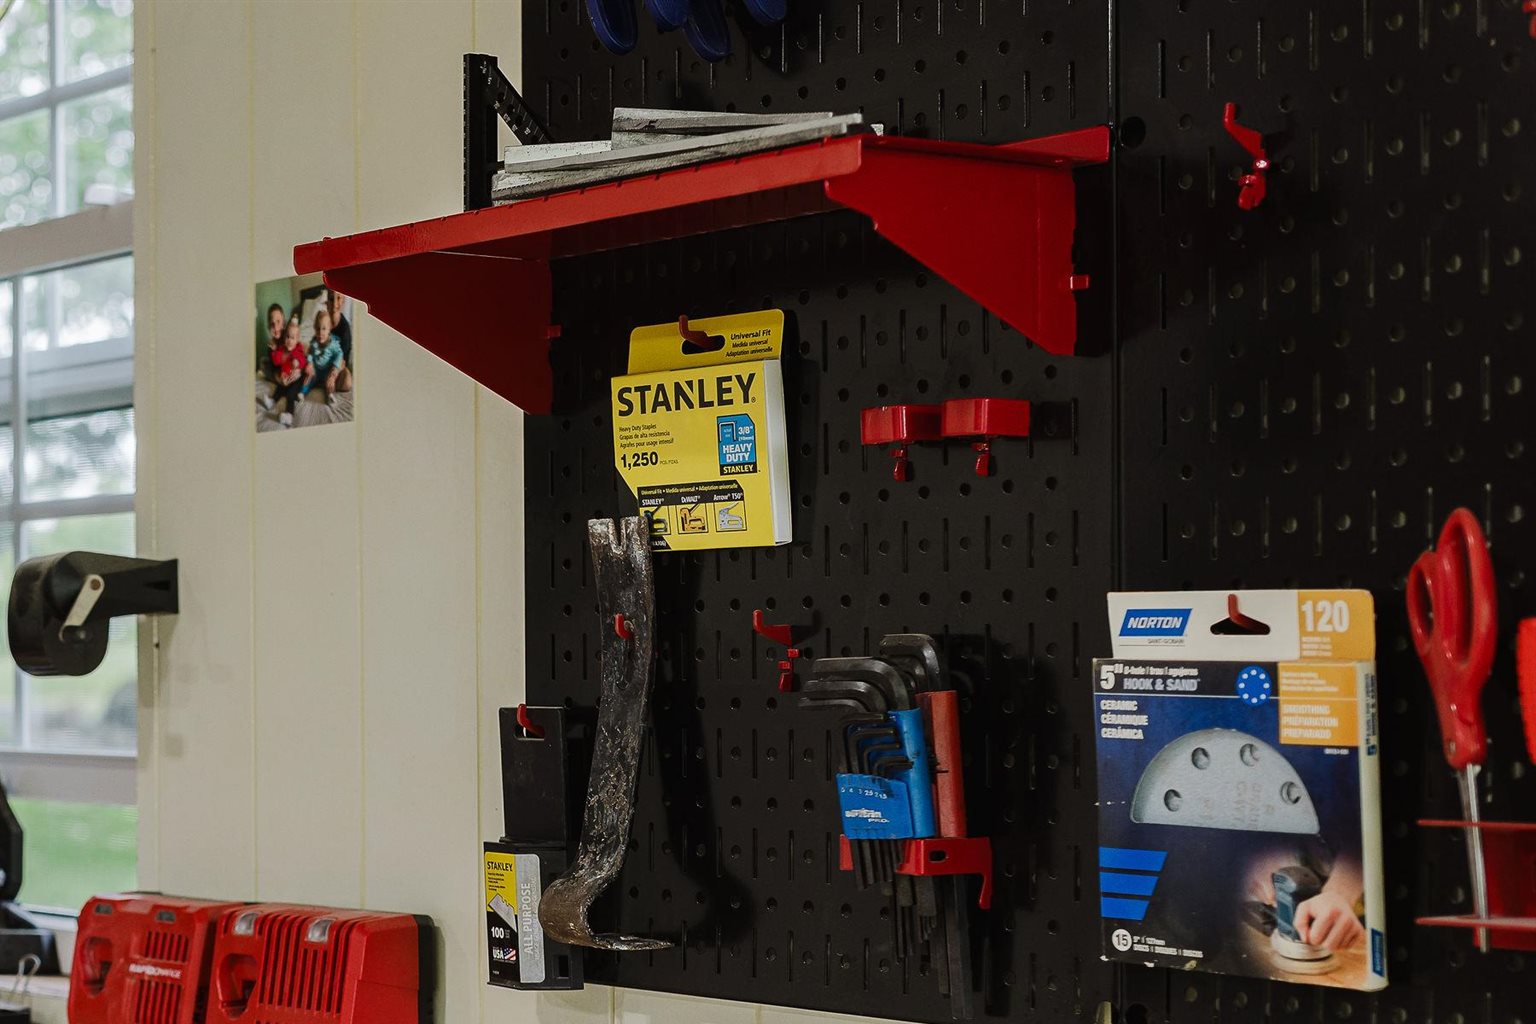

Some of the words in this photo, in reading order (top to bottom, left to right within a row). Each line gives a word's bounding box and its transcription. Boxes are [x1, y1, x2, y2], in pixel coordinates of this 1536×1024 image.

[731, 330, 761, 340] Universal
[617, 373, 756, 417] STANLEY
[723, 443, 752, 454] HEAVY
[621, 451, 658, 470] 1,250
[726, 452, 749, 462] DUTY
[723, 464, 754, 474] STANLEY
[1127, 616, 1183, 629] NORTON
[1301, 600, 1350, 633] 120
[1123, 678, 1153, 690] HOOK
[1154, 679, 1164, 691] &
[1166, 679, 1198, 691] SAND
[487, 861, 513, 872] STANLEY
[521, 883, 533, 933] PURPOSE
[491, 926, 504, 939] 100
[524, 934, 533, 954] ALL
[1116, 934, 1128, 946] 15
[493, 949, 504, 959] USA
